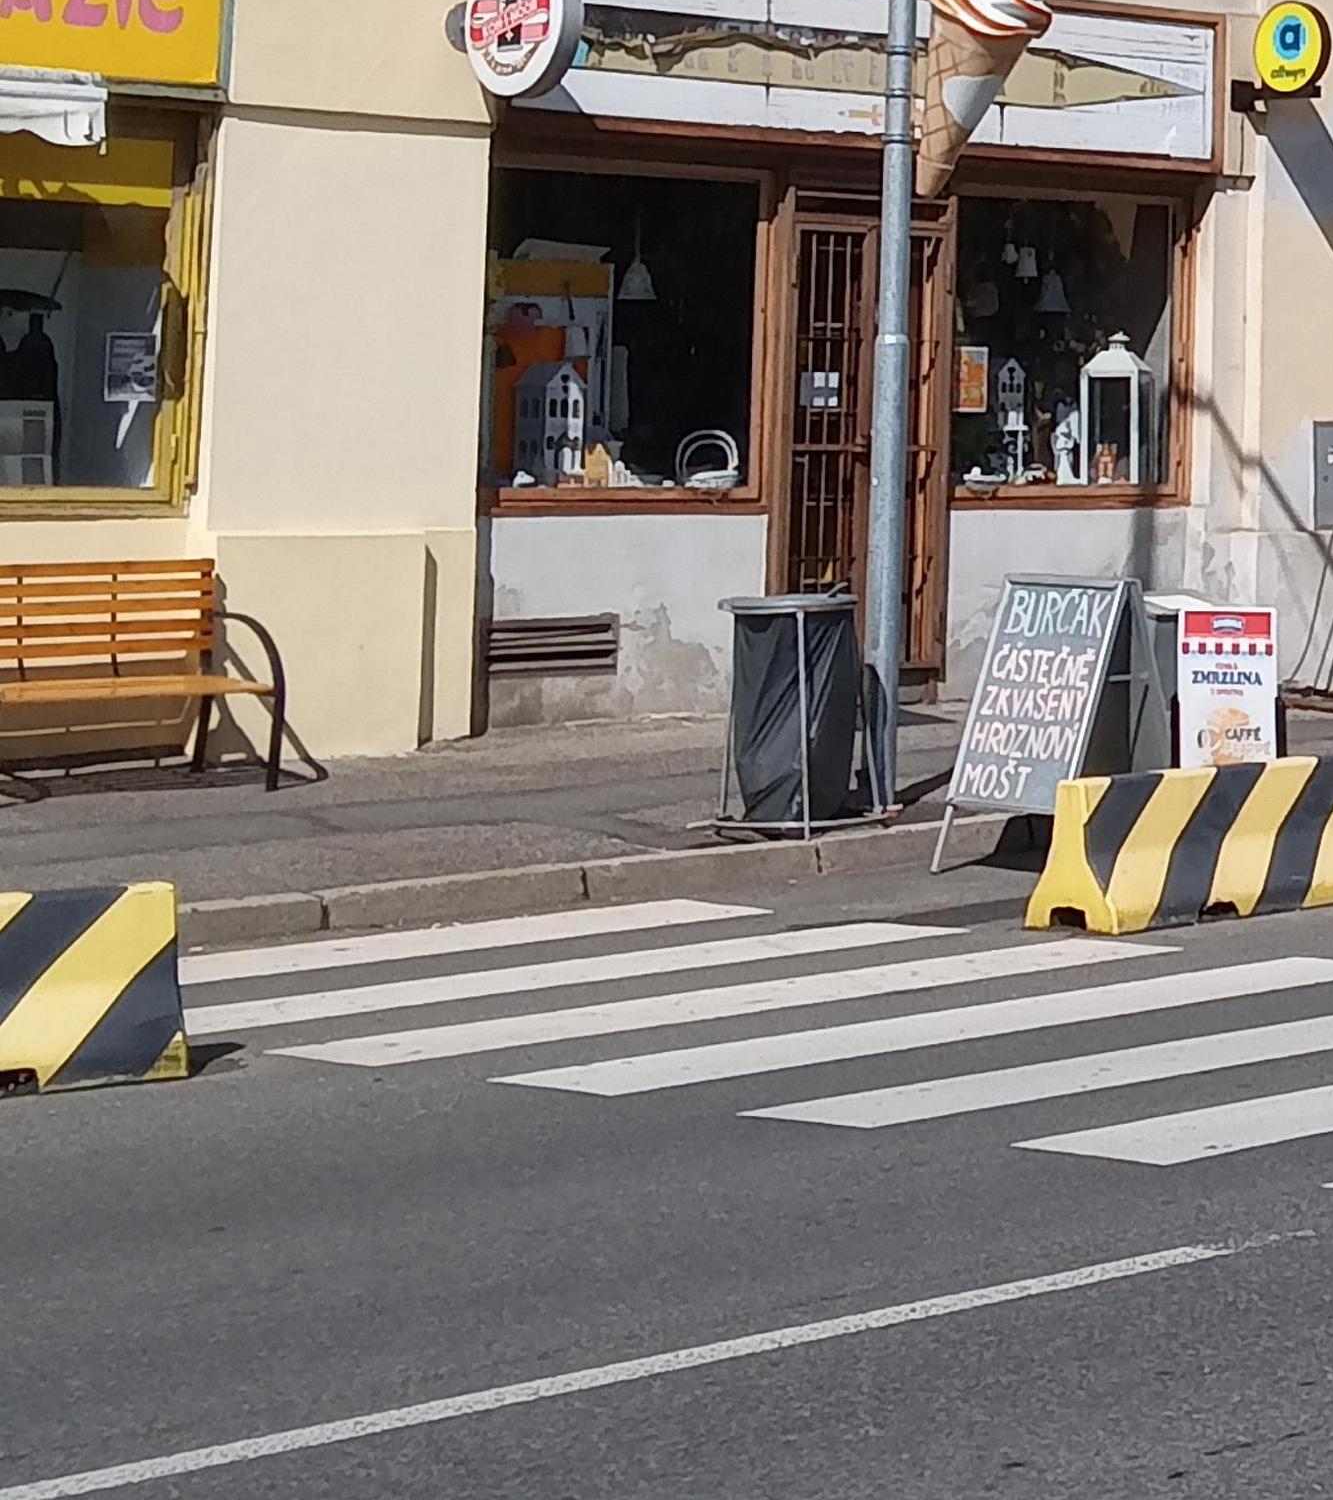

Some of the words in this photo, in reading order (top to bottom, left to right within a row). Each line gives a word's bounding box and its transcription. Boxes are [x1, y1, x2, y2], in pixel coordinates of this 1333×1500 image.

[1003, 588, 1111, 638] BURČÁK
[1191, 670, 1263, 686] ZMRZLINA
[970, 721, 1079, 763] HROZNOVÝ
[959, 758, 1033, 799] MOŠT
